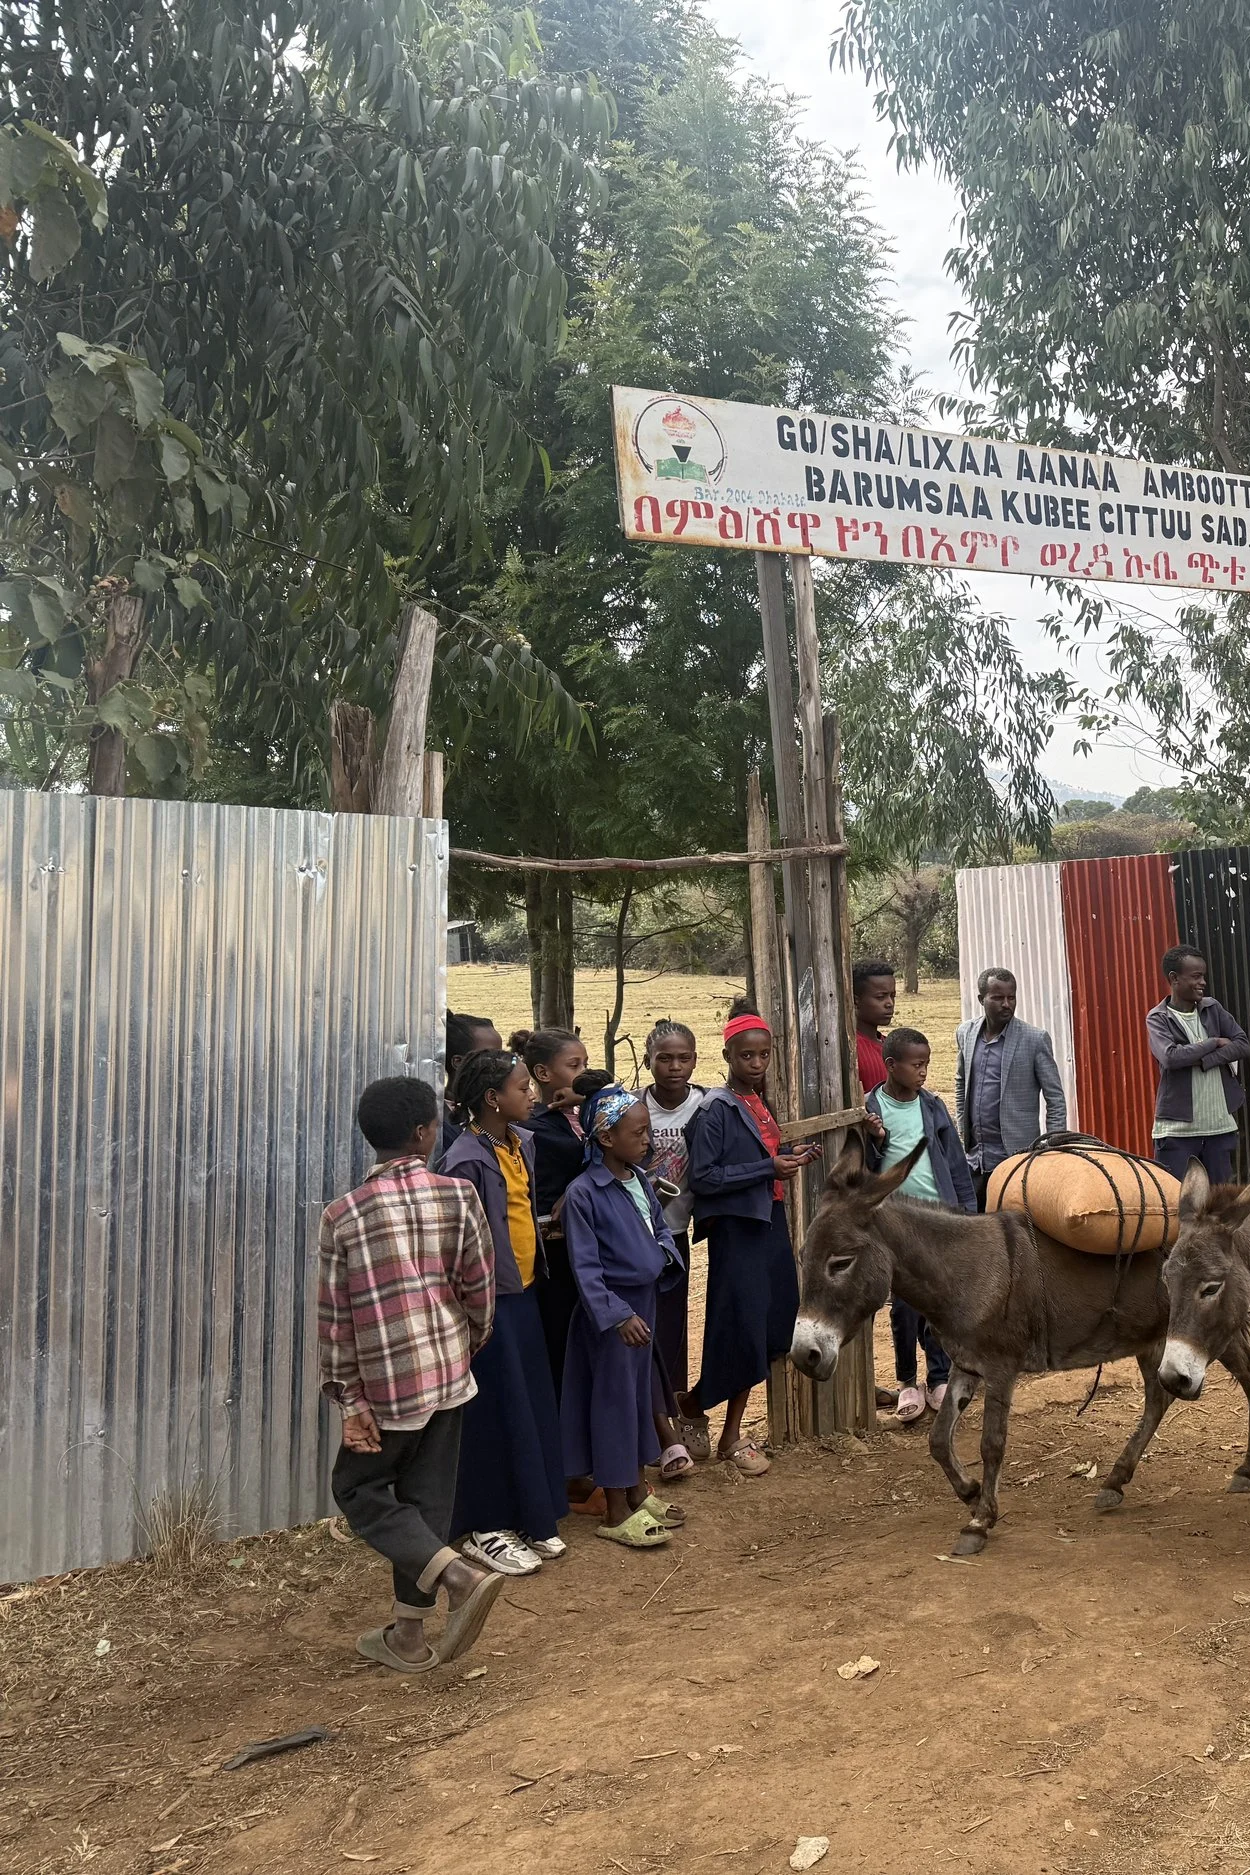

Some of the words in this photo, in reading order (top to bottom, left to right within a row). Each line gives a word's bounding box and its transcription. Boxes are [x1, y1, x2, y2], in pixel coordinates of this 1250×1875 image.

[776, 415, 1002, 479] GO/SHA/LIXAA
[1016, 449, 1120, 494] AANAA
[805, 465, 993, 521] BARUMSAA
[1002, 490, 1091, 532] KUBEE
[1099, 503, 1192, 541] CITTUU
[835, 517, 889, 556] ዞን
[901, 525, 1020, 567] በአምቦ
[1040, 542, 1113, 577] ወረዳ
[1123, 547, 1178, 580] ኩቤ
